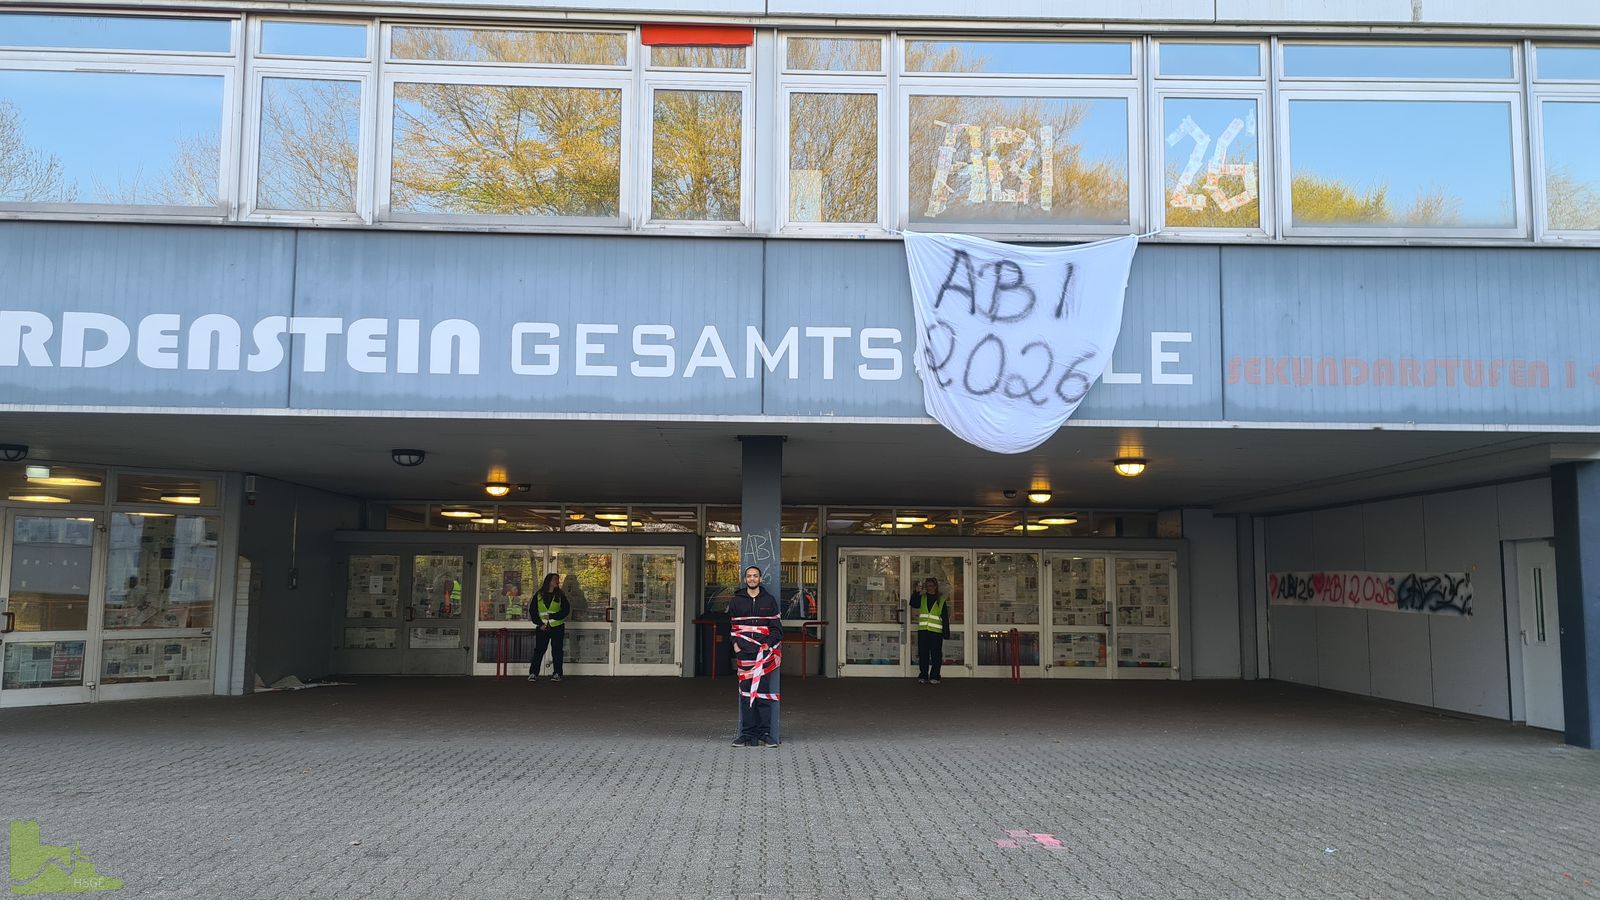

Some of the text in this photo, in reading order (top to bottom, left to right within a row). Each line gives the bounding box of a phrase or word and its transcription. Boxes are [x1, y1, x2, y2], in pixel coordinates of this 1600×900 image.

[925, 119, 1053, 217] ABI
[934, 249, 1075, 323] ABI
[511, 322, 1194, 385] GESAMTSLE
[924, 319, 1099, 406] 2026
[1227, 355, 1549, 388] SEKUNDARSTUFEN
[744, 529, 776, 564] ABI
